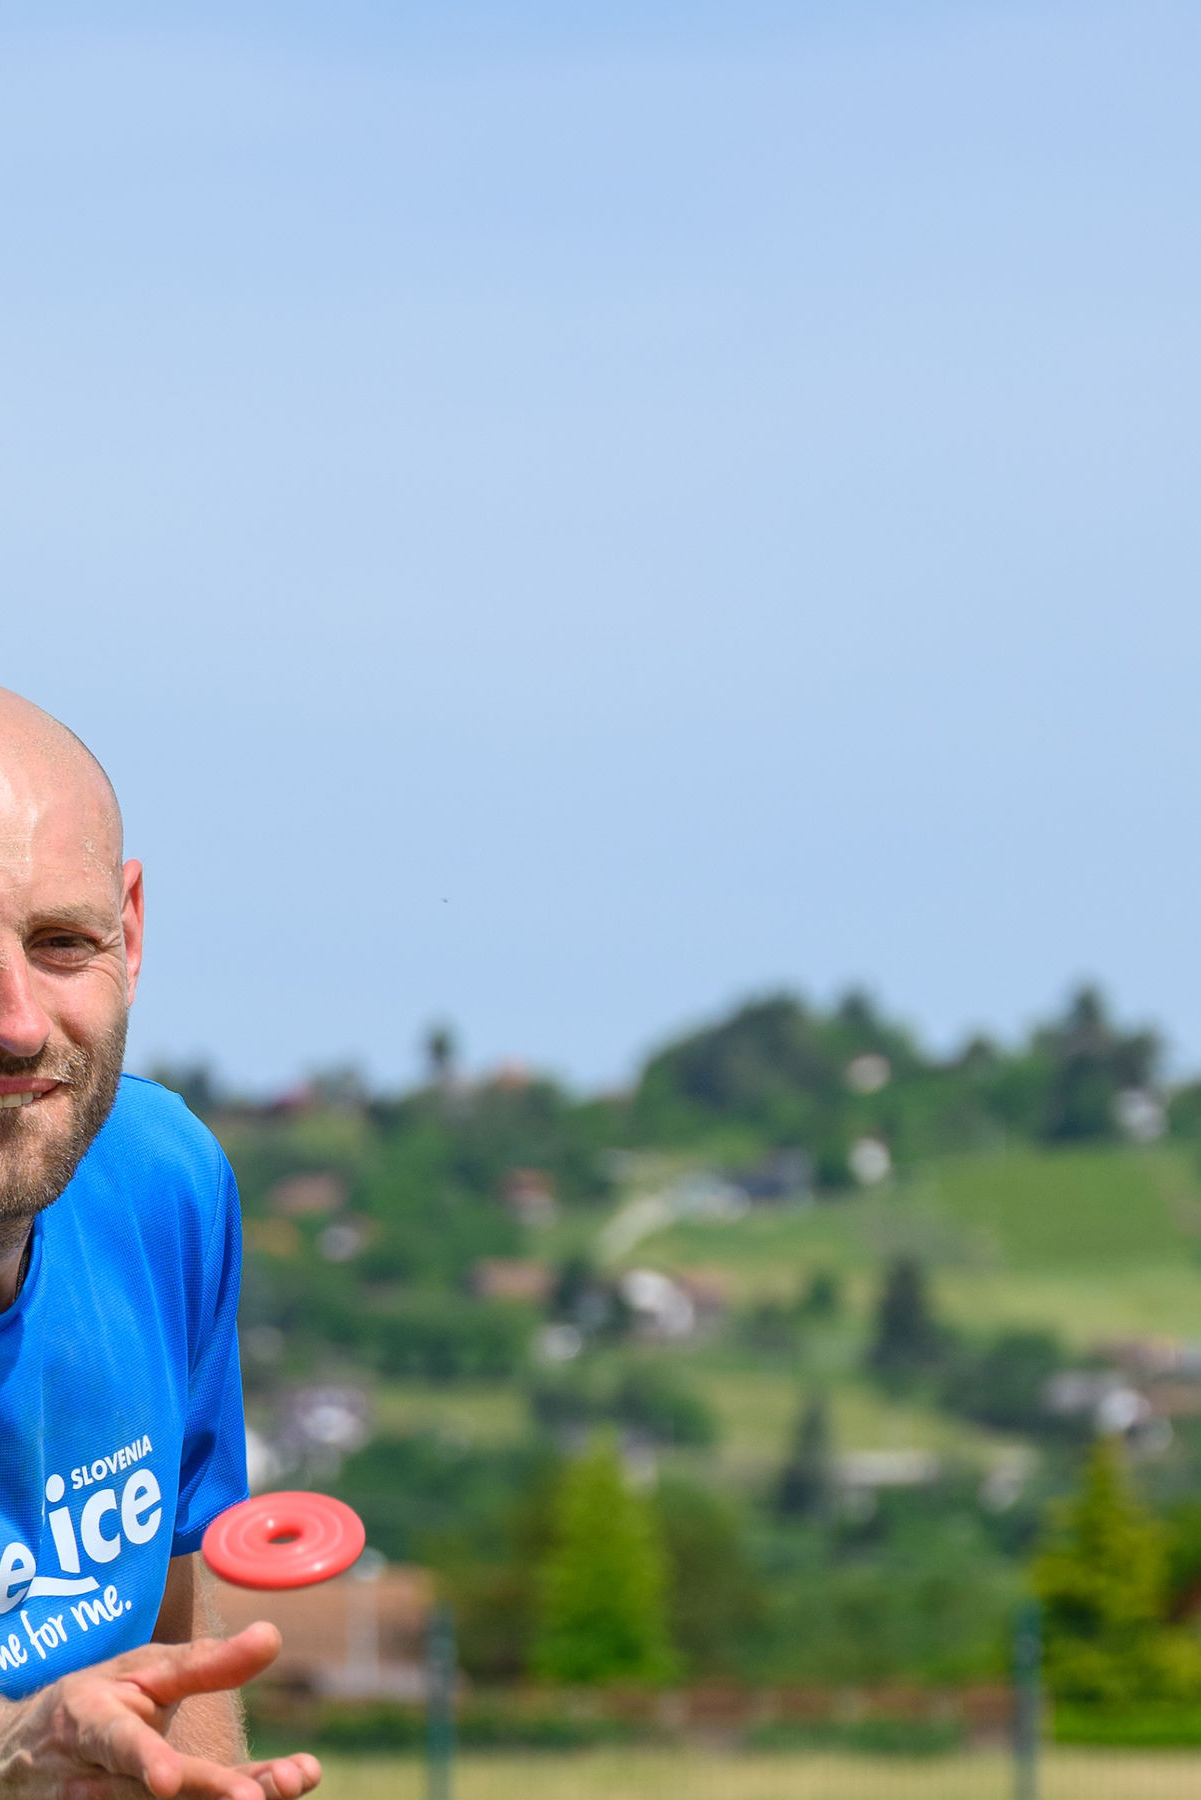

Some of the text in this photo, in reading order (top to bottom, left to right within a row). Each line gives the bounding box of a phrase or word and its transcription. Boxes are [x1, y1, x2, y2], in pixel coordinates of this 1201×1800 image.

[70, 1434, 153, 1490] SLOVENIA
[19, 1609, 68, 1660] for
[70, 1584, 133, 1632] me.
